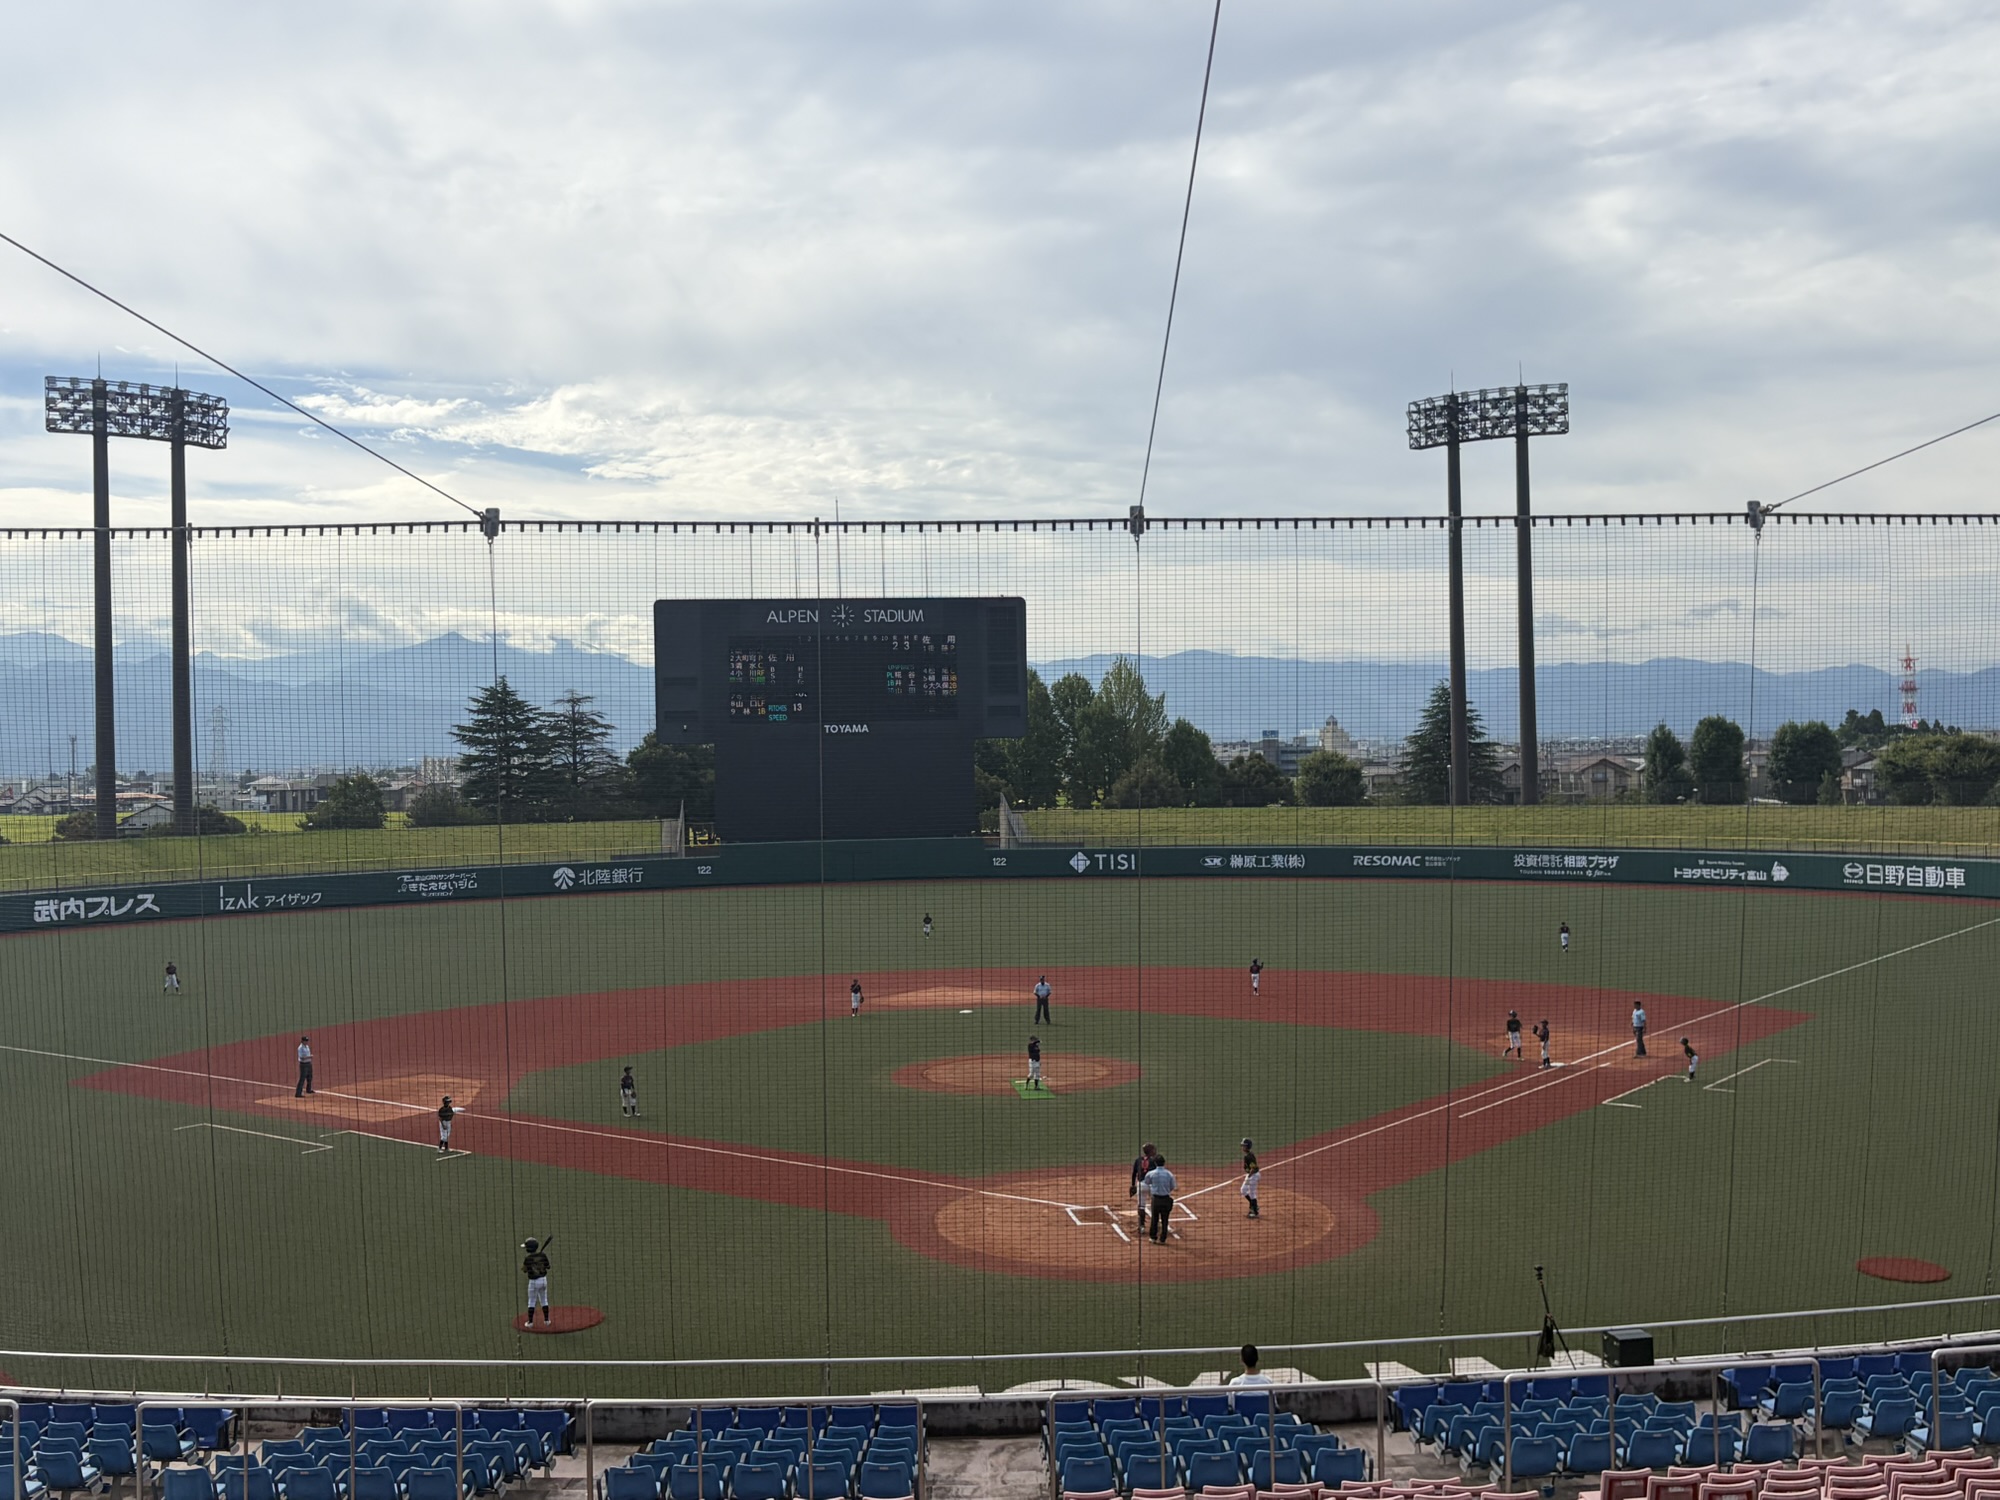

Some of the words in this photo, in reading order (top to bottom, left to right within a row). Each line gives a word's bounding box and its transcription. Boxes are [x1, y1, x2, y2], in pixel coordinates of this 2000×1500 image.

[766, 610, 819, 623] ALPEN
[864, 609, 924, 623] STADIUM
[892, 641, 899, 650] 2
[904, 641, 910, 651] 3
[793, 702, 803, 712] 13
[823, 724, 870, 734] TOYAMA
[992, 857, 1007, 867] 122
[1229, 854, 1306, 869] 榊原工業(株)
[1352, 855, 1422, 867] RESONAC
[1513, 854, 1620, 869] 投資信託相談プラザ
[578, 867, 644, 886] 北陸銀行
[696, 866, 712, 875] 122
[1673, 867, 1767, 881] トヨタモビリティ富山
[1866, 863, 1966, 889] 日野自動車
[408, 878, 478, 892] きたえないジム
[264, 892, 323, 908] アイザック
[33, 893, 161, 923] 武内プレス
